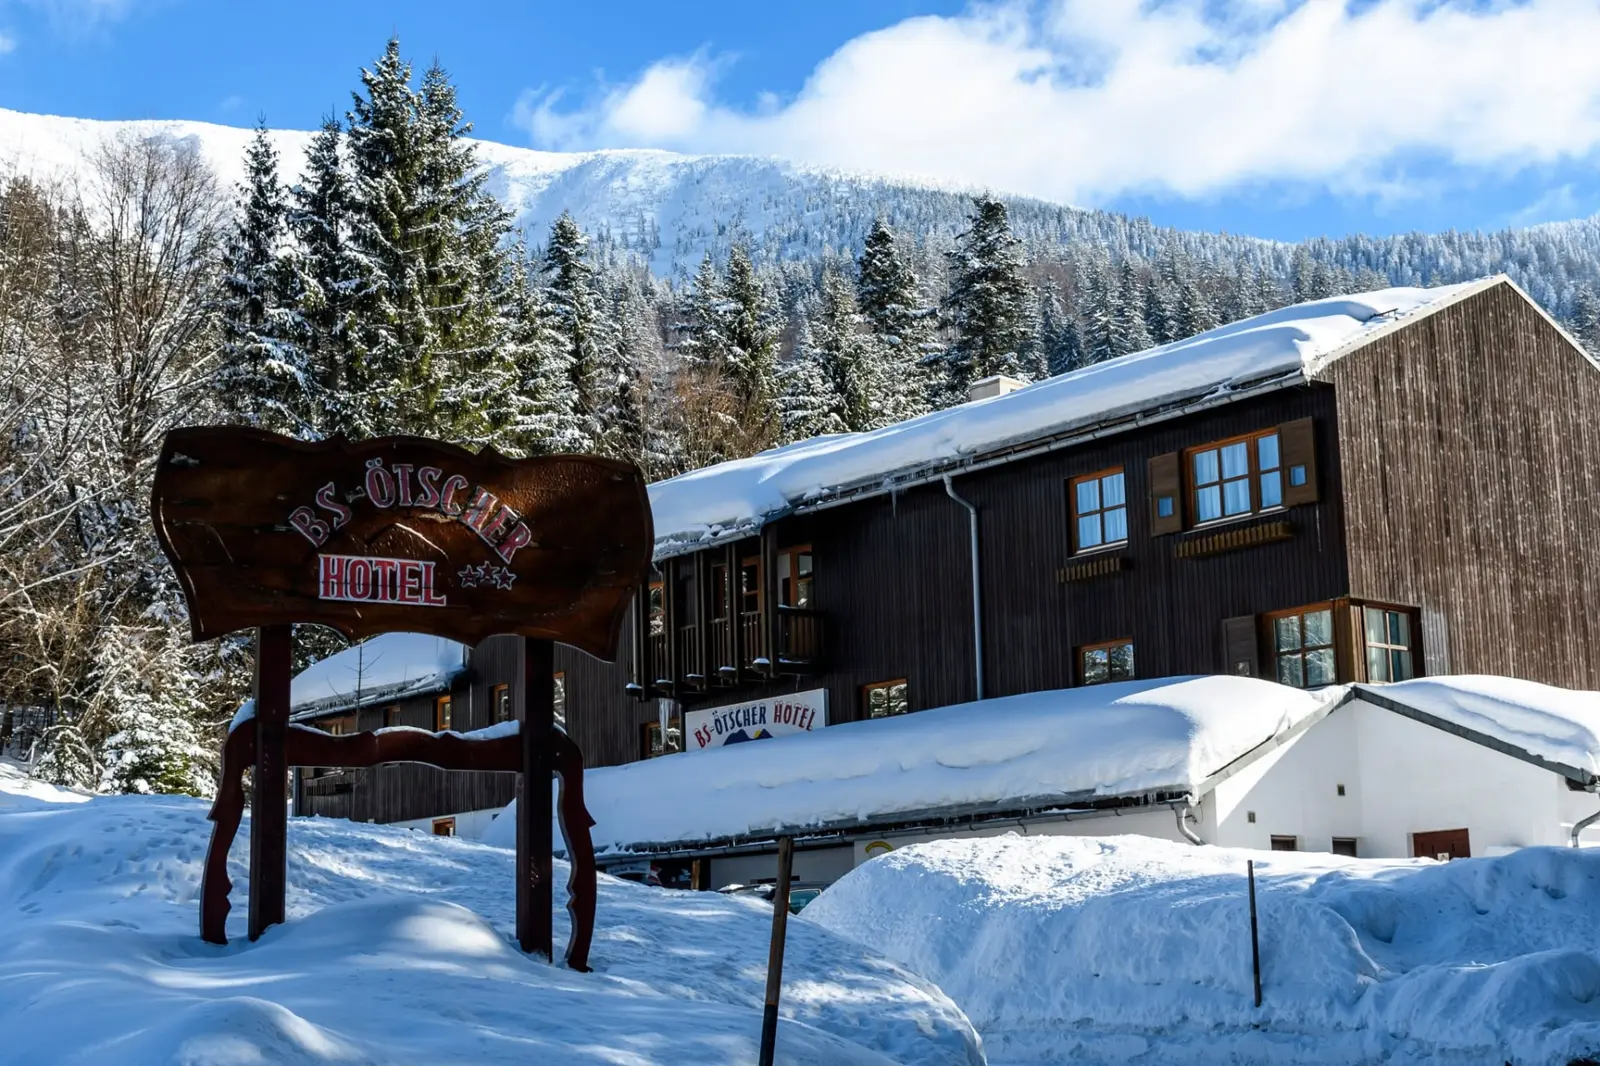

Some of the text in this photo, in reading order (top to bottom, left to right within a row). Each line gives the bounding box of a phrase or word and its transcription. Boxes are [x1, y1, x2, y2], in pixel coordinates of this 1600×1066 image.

[318, 554, 446, 606] HOTEL
[694, 700, 817, 748] BS-ÖTSCHER HOTEL
